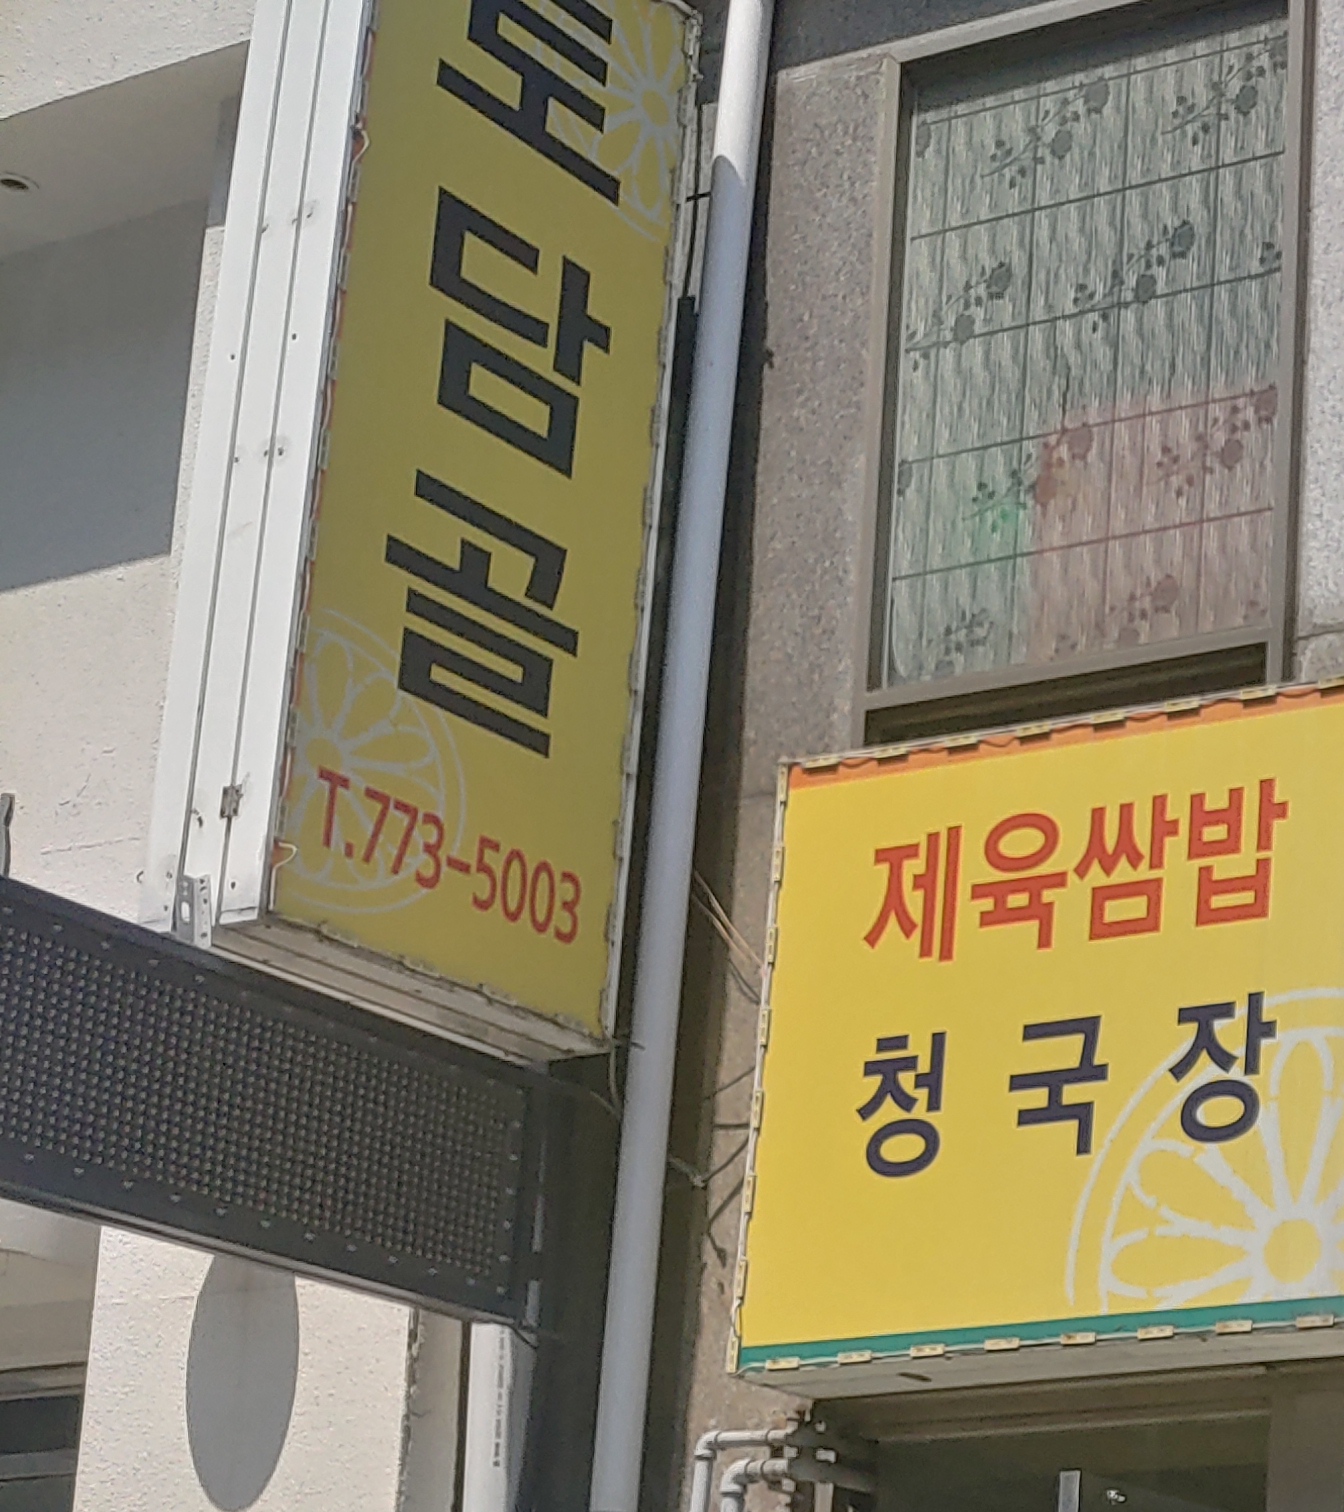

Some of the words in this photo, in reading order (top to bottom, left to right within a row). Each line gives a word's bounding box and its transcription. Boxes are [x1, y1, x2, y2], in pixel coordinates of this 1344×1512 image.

[385, 0, 619, 758] 토담골
[318, 765, 581, 944] T.773-5003
[862, 778, 1289, 962] 제육쌈밥
[856, 991, 1277, 1179] 청국장
